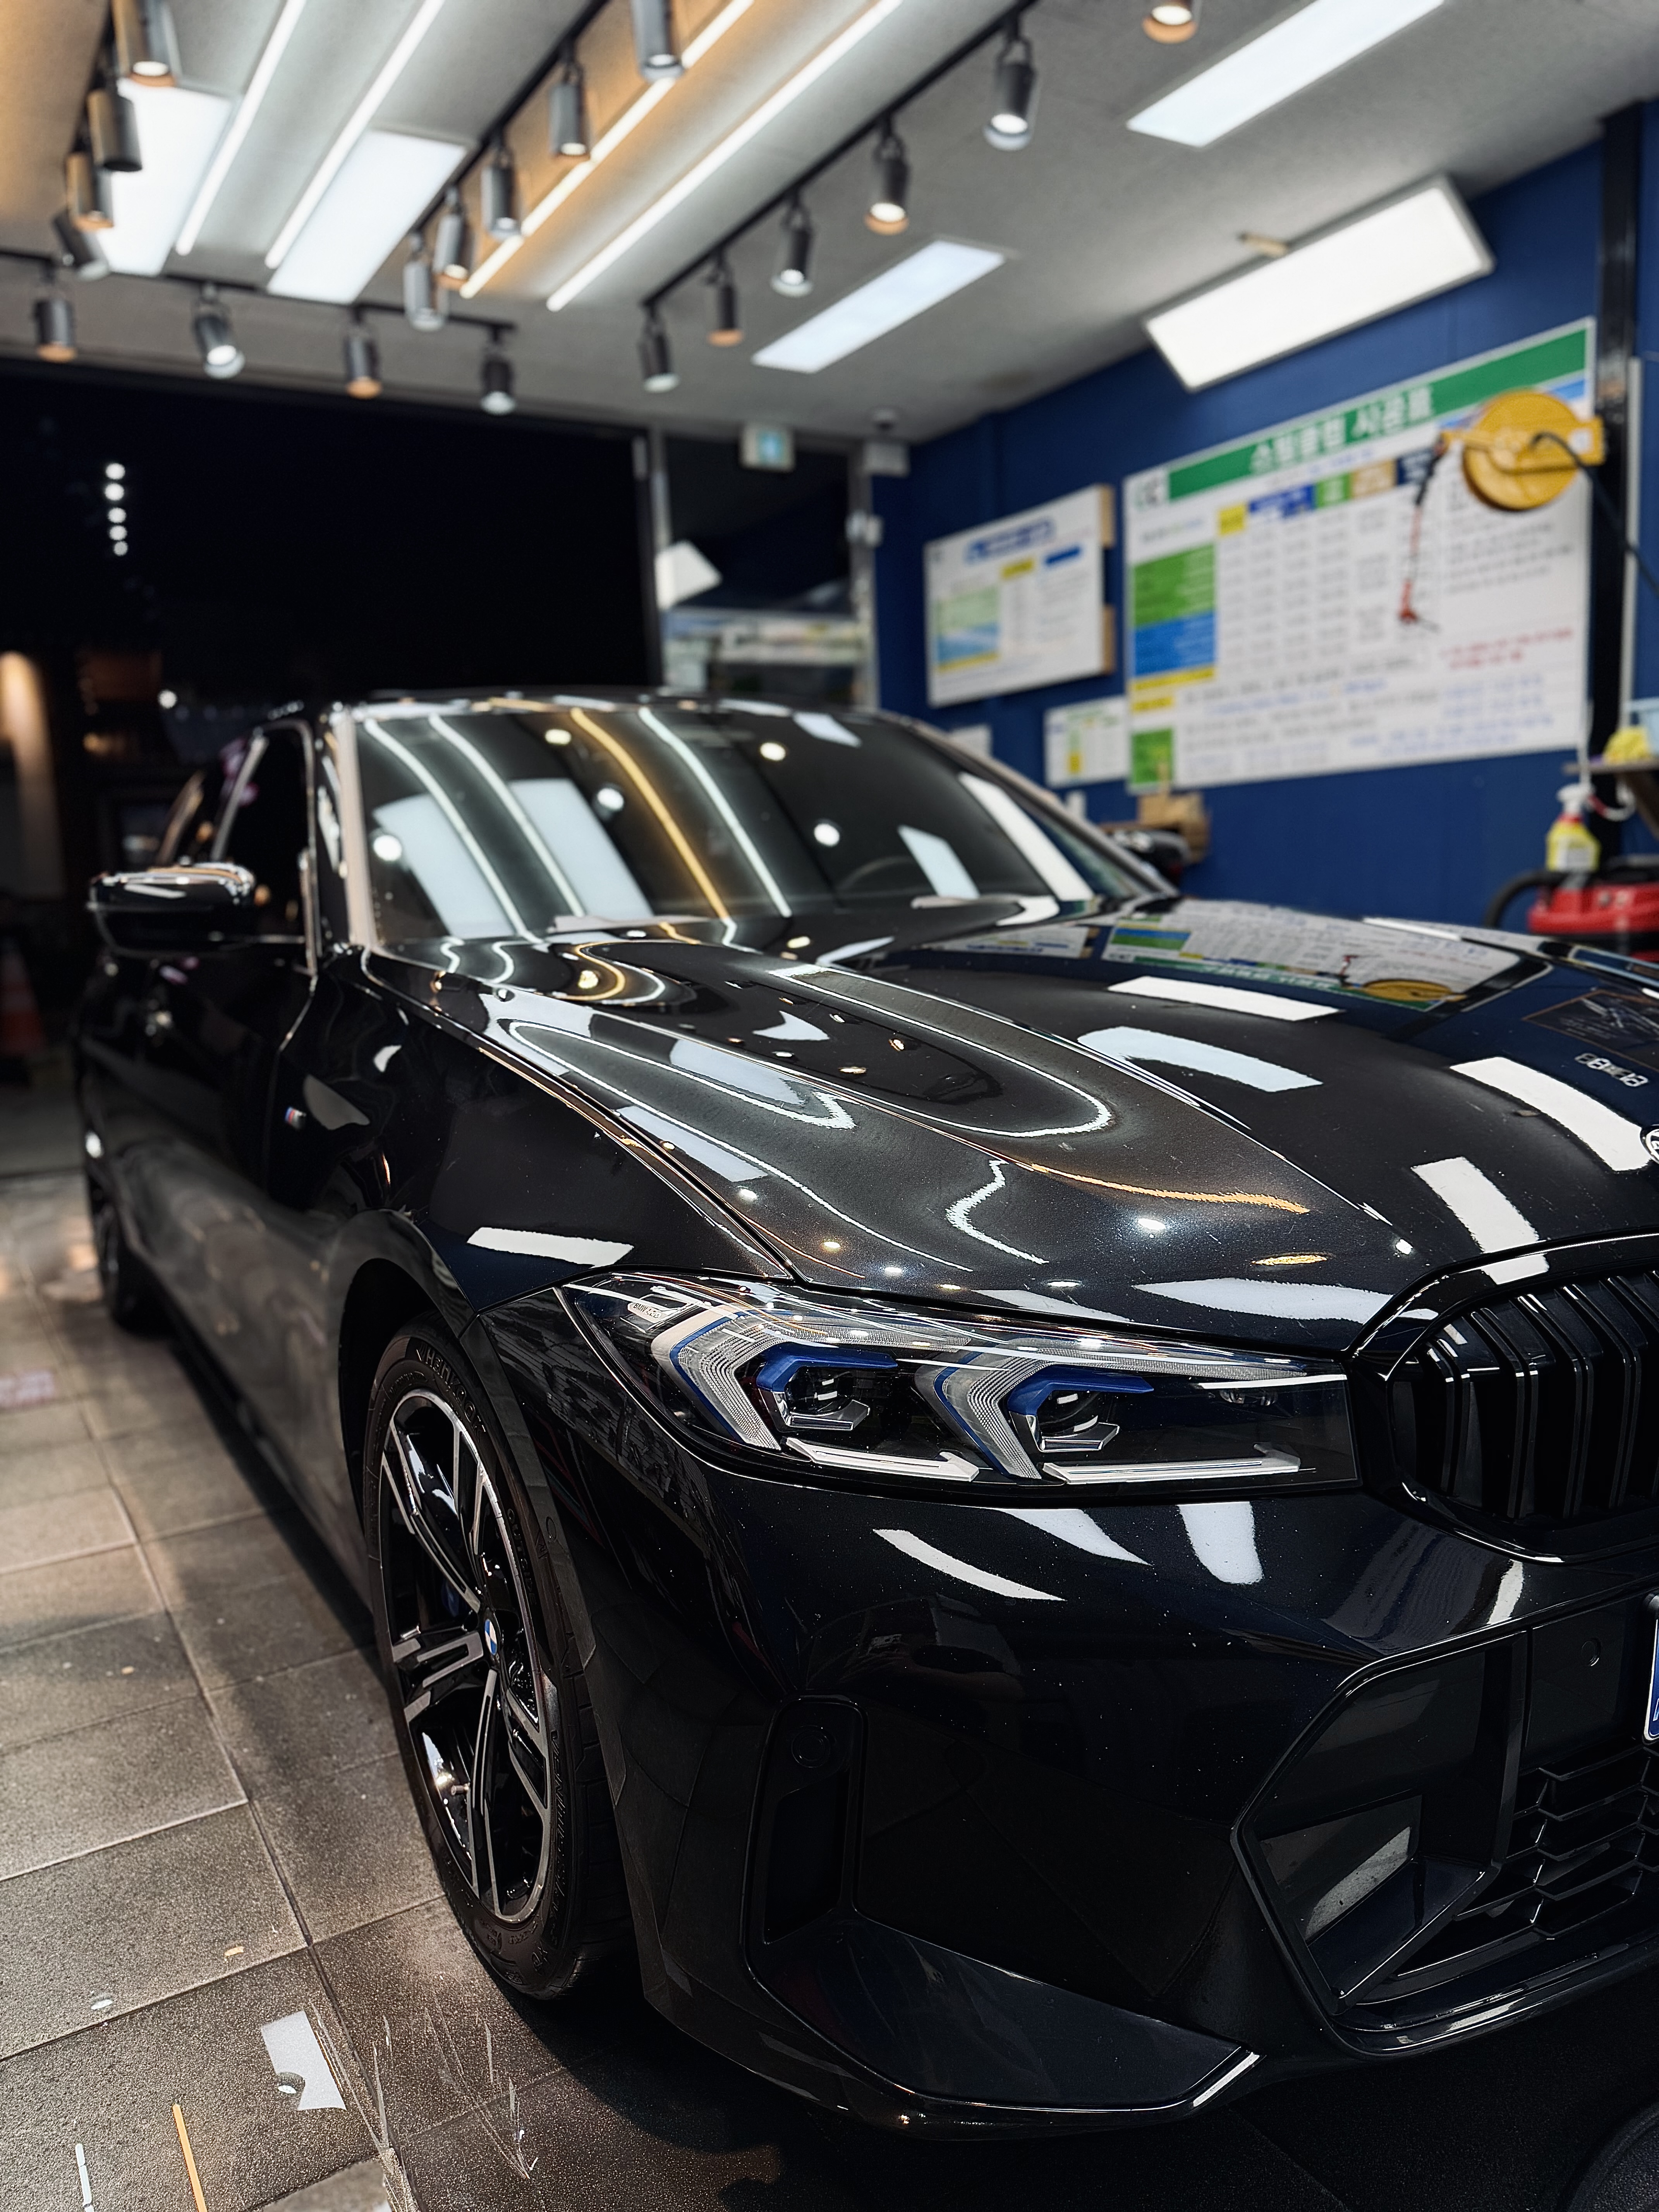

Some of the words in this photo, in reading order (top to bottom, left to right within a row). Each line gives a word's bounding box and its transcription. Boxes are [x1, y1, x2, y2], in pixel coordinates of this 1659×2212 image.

[633, 1303, 648, 1312] BMW
[425, 1348, 486, 1442] Hankook
[507, 1508, 538, 1606] OUTSIDE
